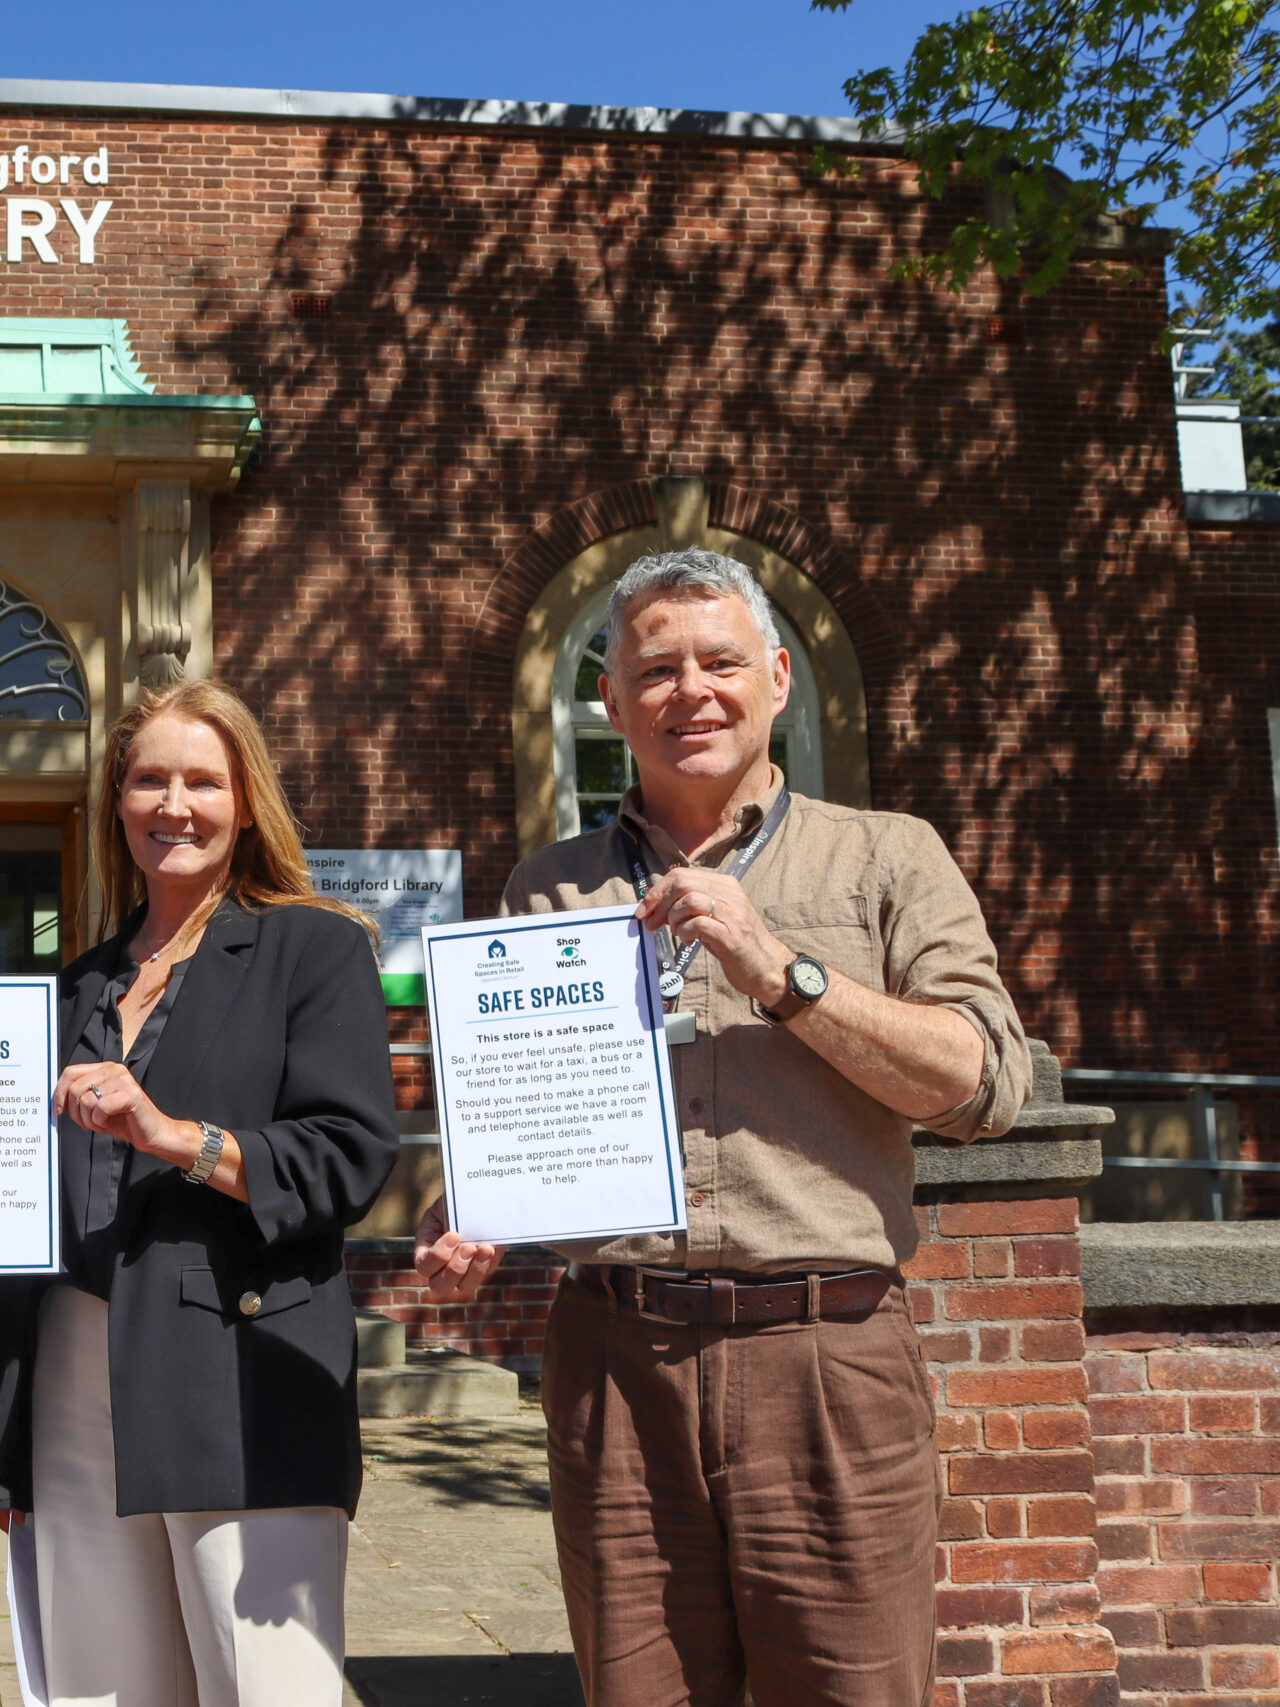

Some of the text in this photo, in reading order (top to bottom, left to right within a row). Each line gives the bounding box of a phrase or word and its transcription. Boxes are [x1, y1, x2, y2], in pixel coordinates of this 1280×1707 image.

[738, 837, 764, 865] Inspire
[307, 857, 345, 869] nspire
[321, 879, 389, 894] Bridgford
[393, 879, 443, 894] Library
[556, 937, 580, 946] Shop
[555, 957, 586, 968] Watch
[660, 975, 681, 993] Shh!
[477, 980, 604, 1013] SAFE SPACES
[476, 1033, 499, 1043] This
[502, 1031, 530, 1041] store
[533, 1029, 543, 1037] is
[555, 1025, 578, 1035] safe
[581, 1023, 614, 1034] space
[450, 1038, 644, 1064] So, if you ever feel unsafe, please use
[455, 1068, 472, 1077] our
[475, 1066, 500, 1075] store
[503, 1064, 513, 1072] to
[516, 1061, 537, 1070] wait
[539, 1059, 553, 1068] for
[556, 1059, 563, 1067] a
[566, 1057, 587, 1066] taxi,
[600, 1053, 619, 1062] bus
[622, 1052, 632, 1060] or
[466, 1065, 634, 1088] friend for as long as you need to.
